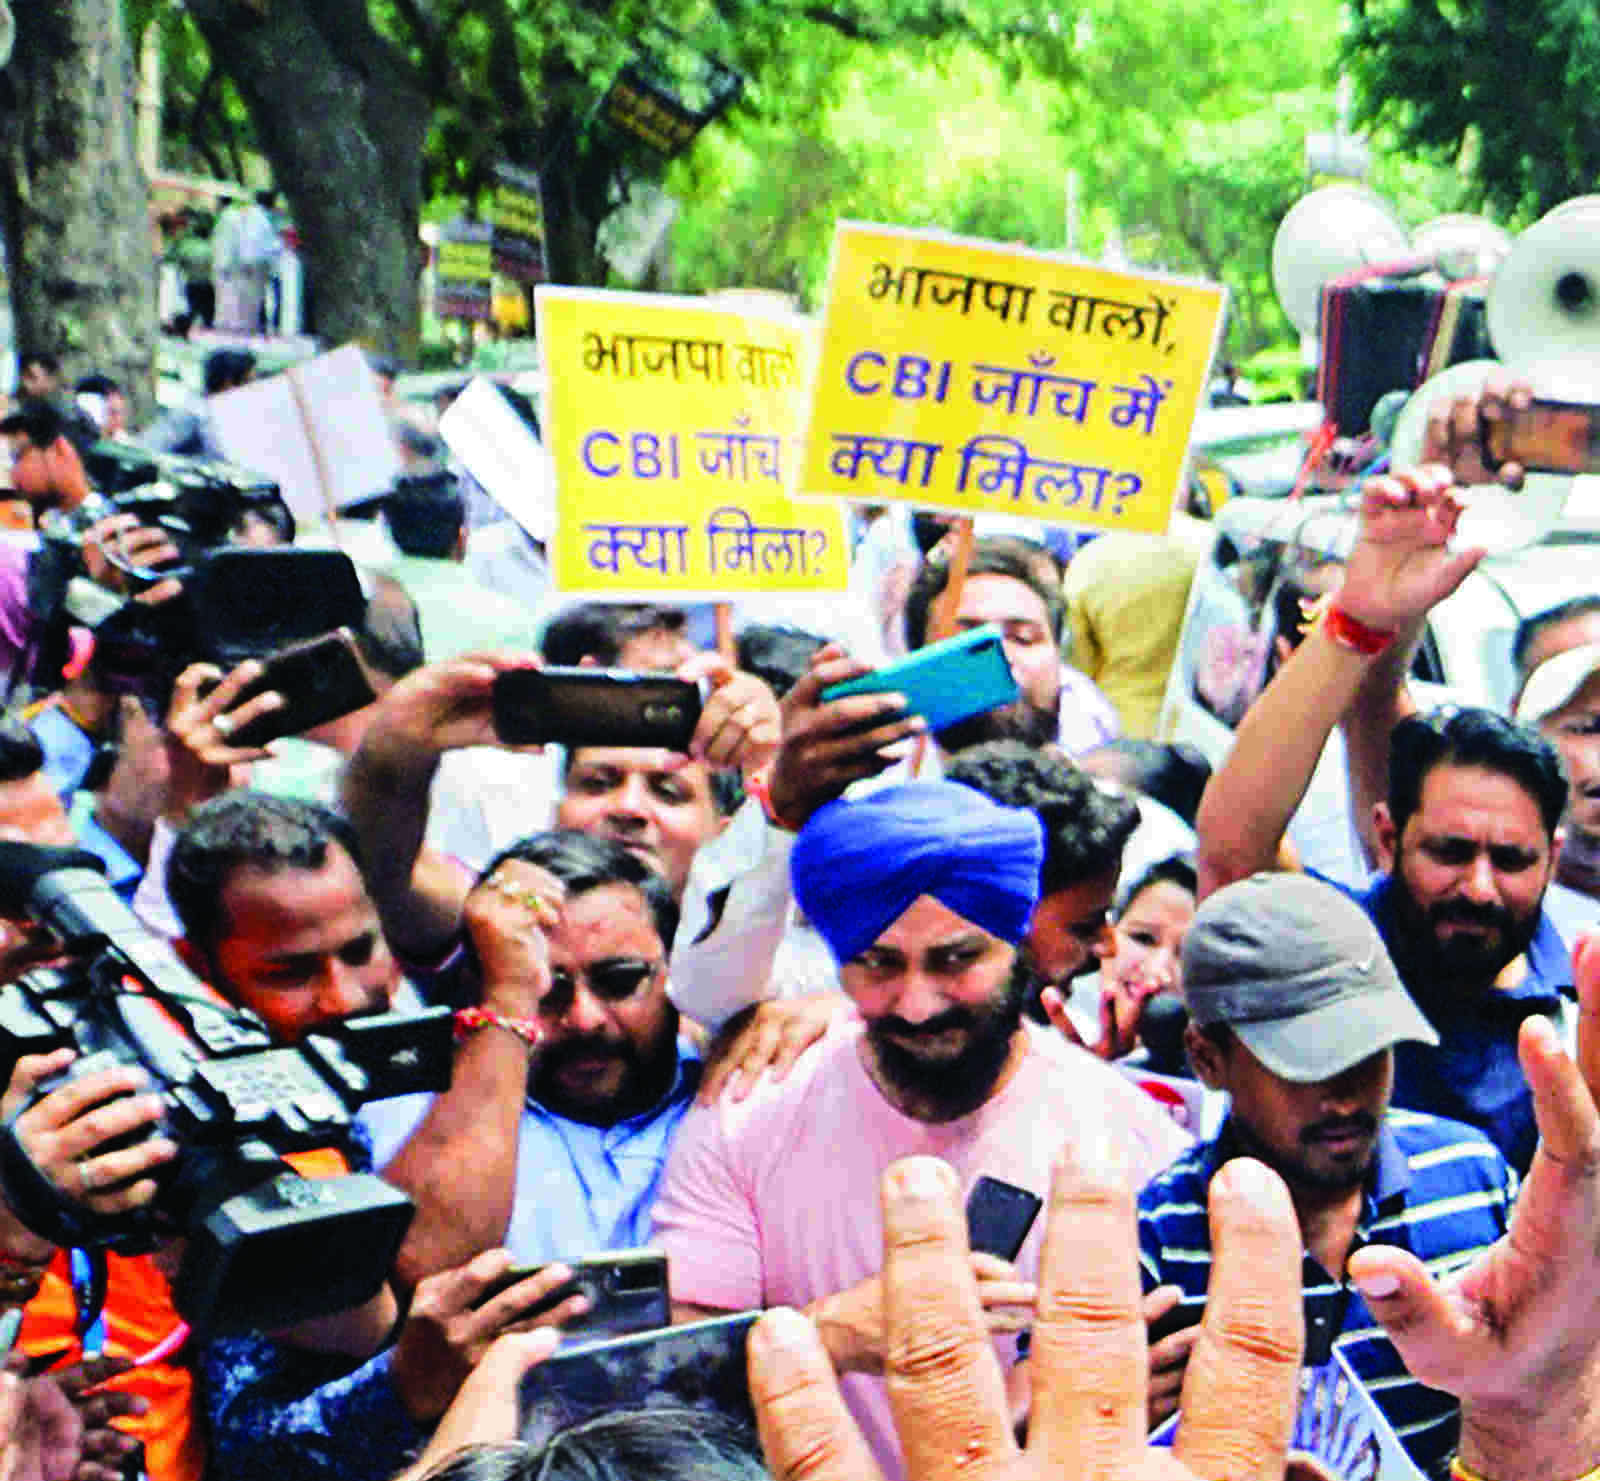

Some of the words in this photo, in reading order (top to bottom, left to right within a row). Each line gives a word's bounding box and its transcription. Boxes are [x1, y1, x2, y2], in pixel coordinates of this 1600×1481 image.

[868, 263, 1035, 322] भाजपा
[1049, 291, 1177, 356] वालों,
[583, 333, 724, 381] भाजपा
[846, 352, 951, 402] CBI
[971, 350, 1096, 424] जाँच
[1110, 374, 1174, 436] में
[582, 430, 680, 479] CBI
[694, 411, 780, 483] जाँच
[830, 433, 942, 486] क्या
[956, 434, 1142, 515] मिला?
[582, 524, 688, 574] क्या
[705, 506, 827, 575] मिला?
